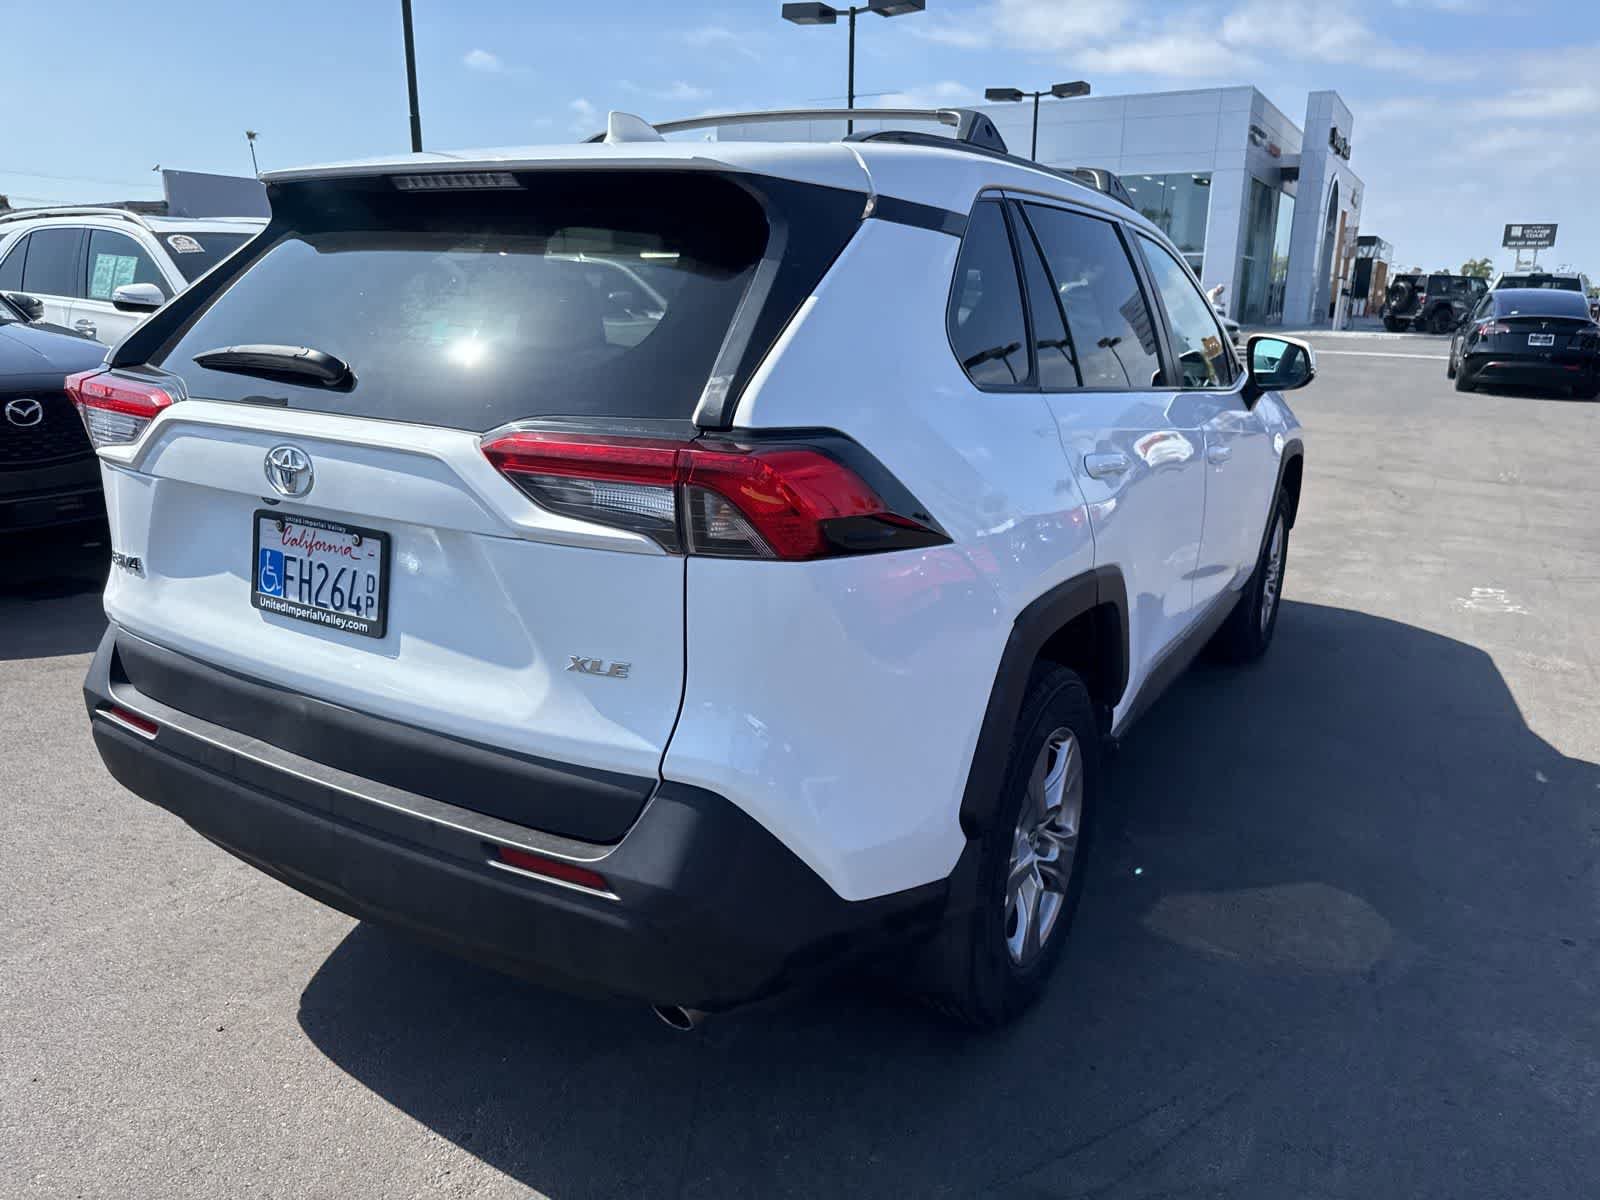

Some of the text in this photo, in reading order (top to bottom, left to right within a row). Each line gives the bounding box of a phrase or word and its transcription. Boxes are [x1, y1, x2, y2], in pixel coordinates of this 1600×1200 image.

[281, 524, 362, 561] California
[302, 517, 327, 529] Imperial
[327, 522, 347, 534] Valley
[283, 555, 362, 617] FH264
[259, 597, 369, 633] UnitedImperialValley.com
[565, 655, 632, 678] XLE
